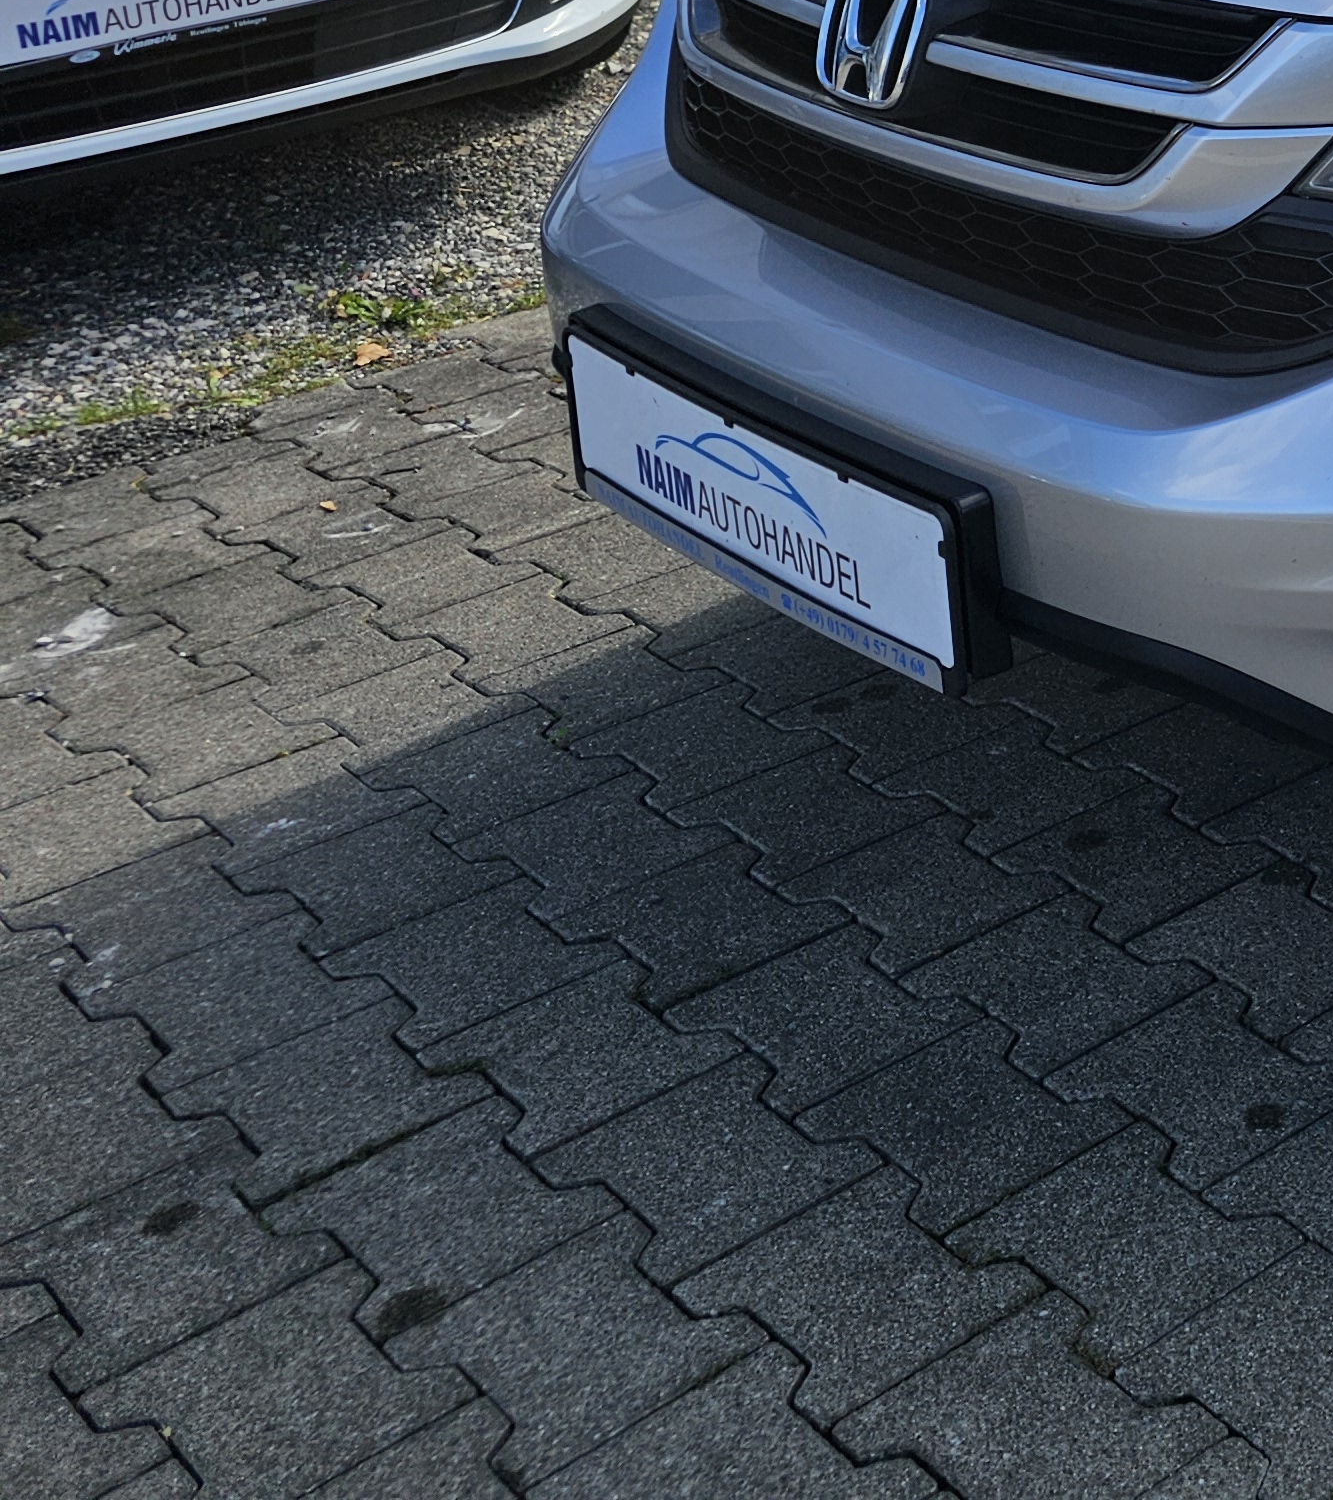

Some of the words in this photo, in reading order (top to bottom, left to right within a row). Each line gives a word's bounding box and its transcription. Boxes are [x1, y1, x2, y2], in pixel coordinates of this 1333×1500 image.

[16, 11, 100, 49] NAIM
[635, 443, 696, 516] NAIM
[698, 480, 872, 610] AUTOHANDEL
